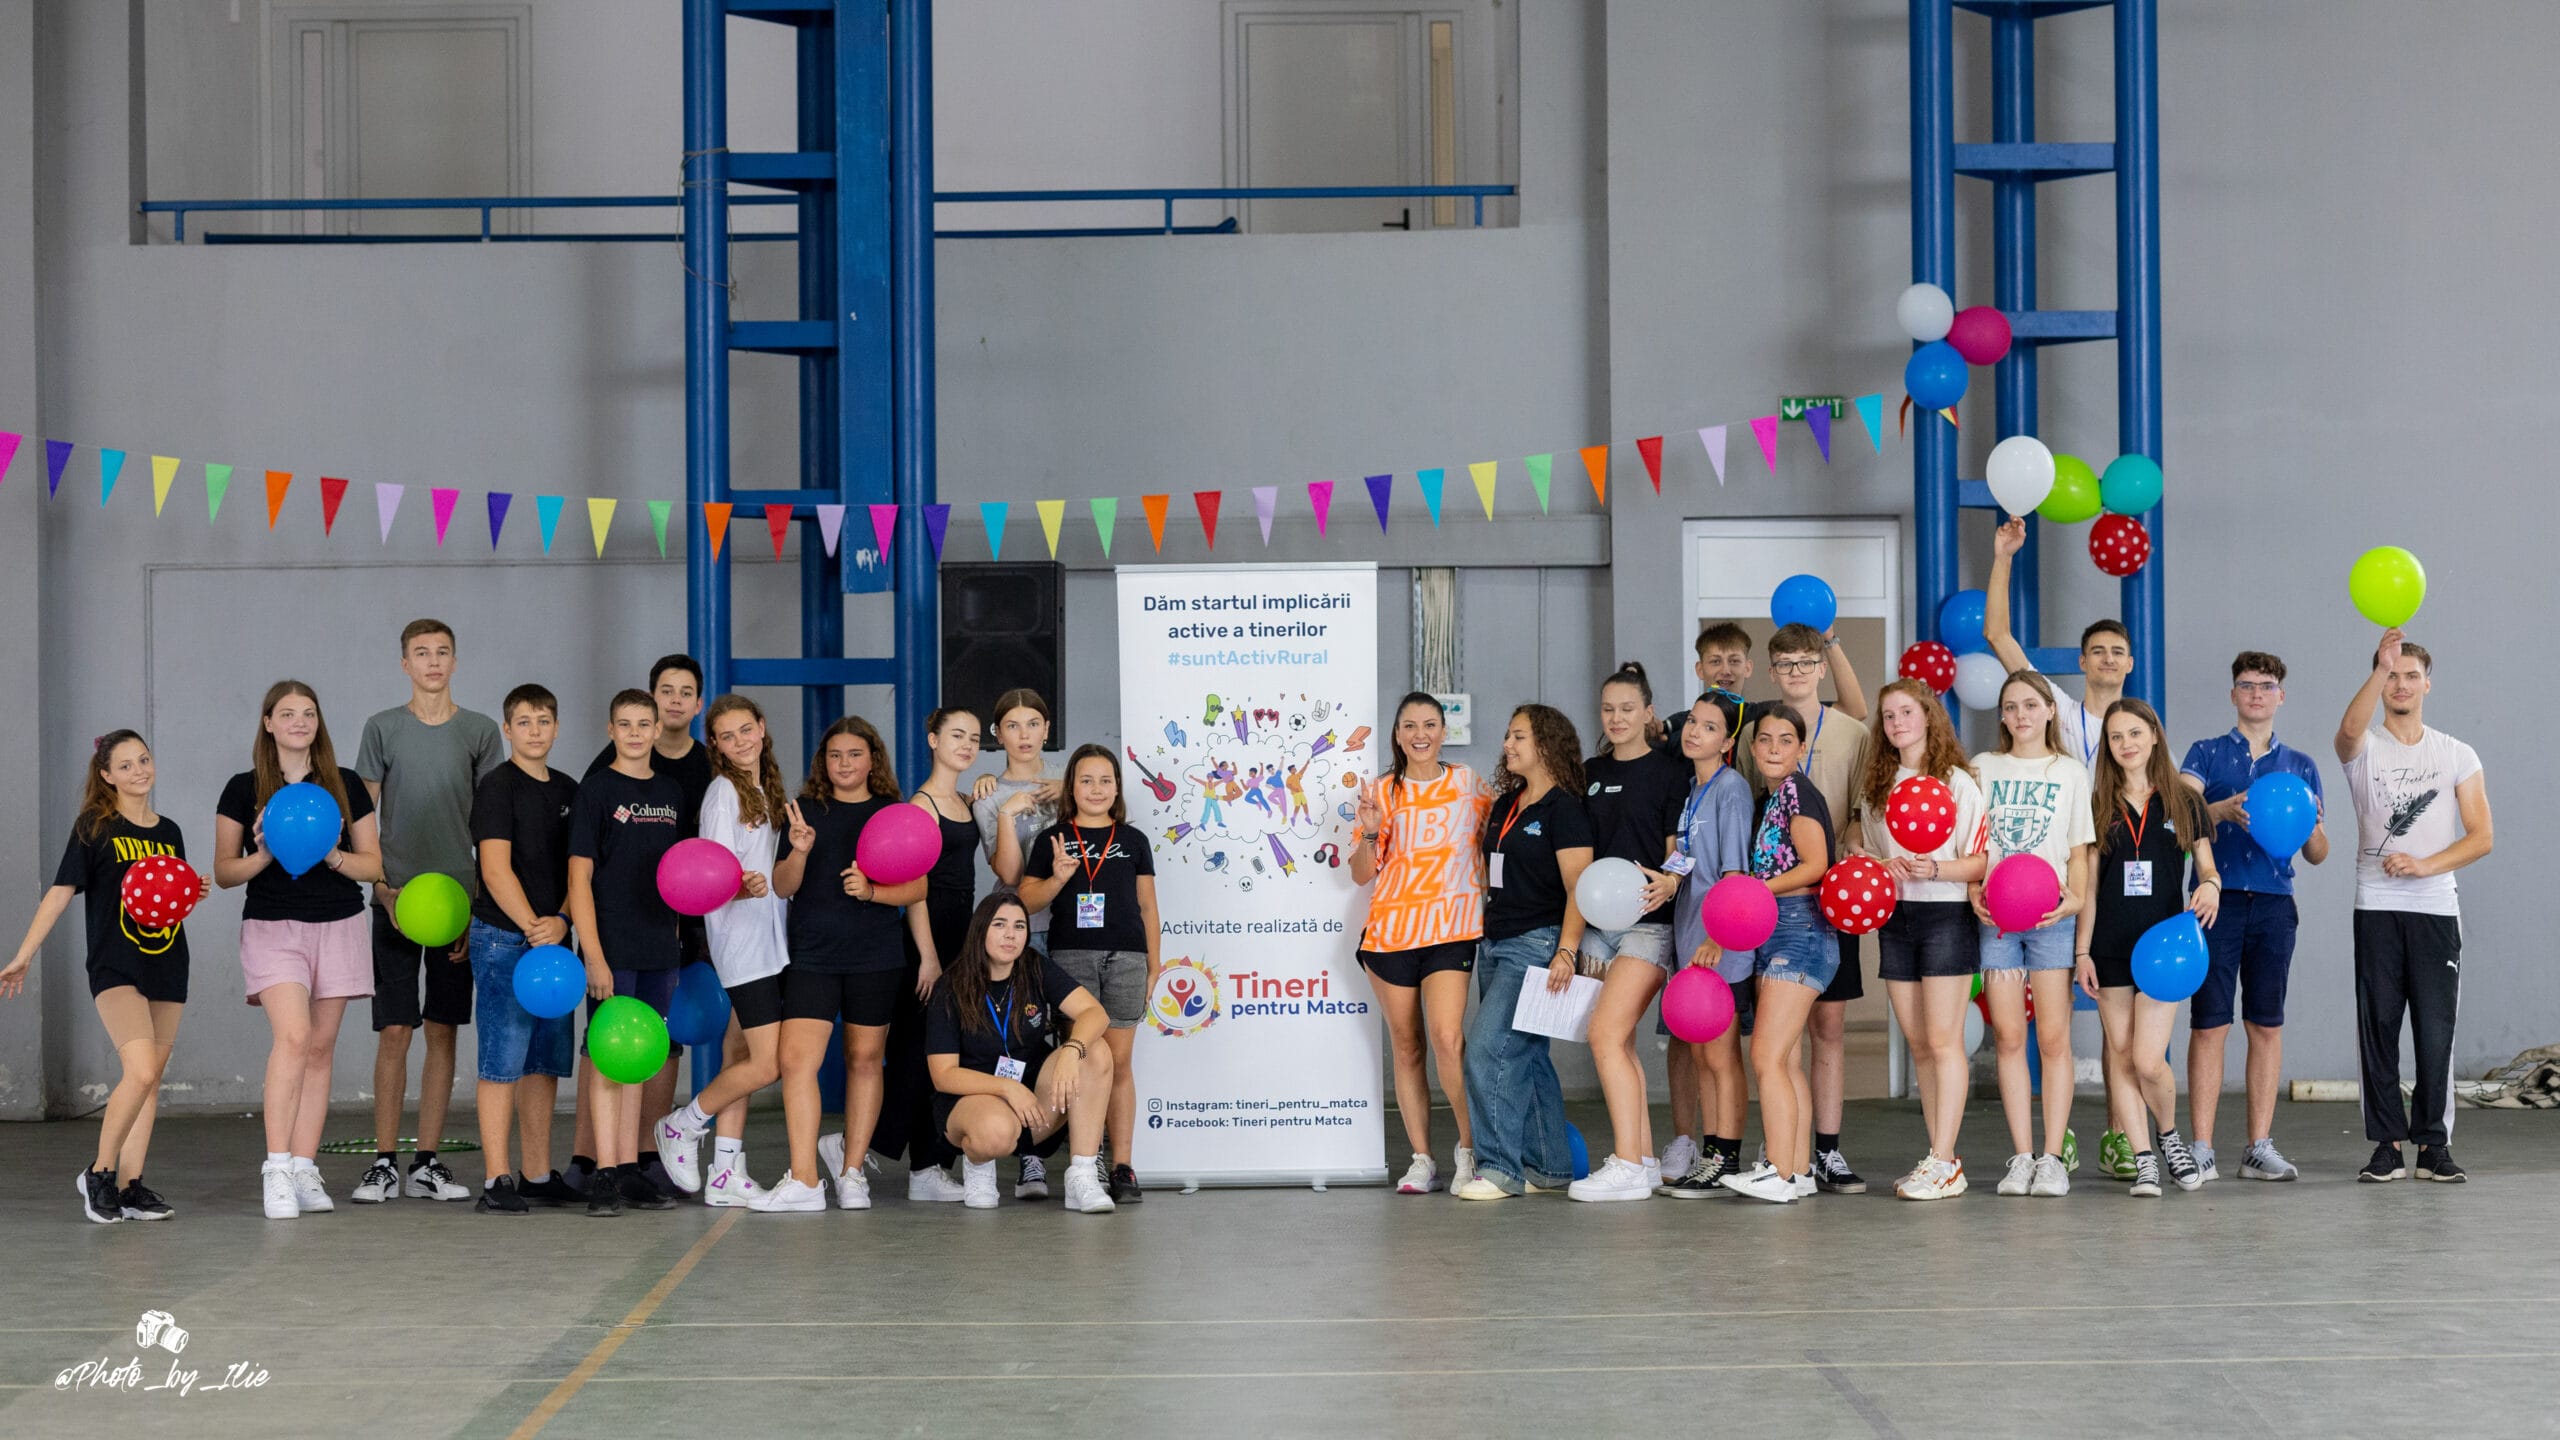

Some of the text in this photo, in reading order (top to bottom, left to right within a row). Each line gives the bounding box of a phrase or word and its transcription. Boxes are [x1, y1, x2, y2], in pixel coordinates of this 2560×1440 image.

[1143, 592, 1351, 614] Dăm startul implicării
[1167, 621, 1328, 639] active a tinerilor
[1168, 649, 1328, 666] #suntActivRural
[1989, 780, 2061, 814] NIKE
[630, 803, 677, 820] Columbia
[112, 836, 176, 863] NIRVAN
[1160, 918, 1344, 935] Activitate realizată de
[1228, 969, 1329, 999] Tineri
[1231, 999, 1369, 1020] pentru Matca
[1166, 1098, 1368, 1113] Instagram: tineri_pentru_matca
[1166, 1115, 1353, 1129] Facebook: Tineri pentru Matca
